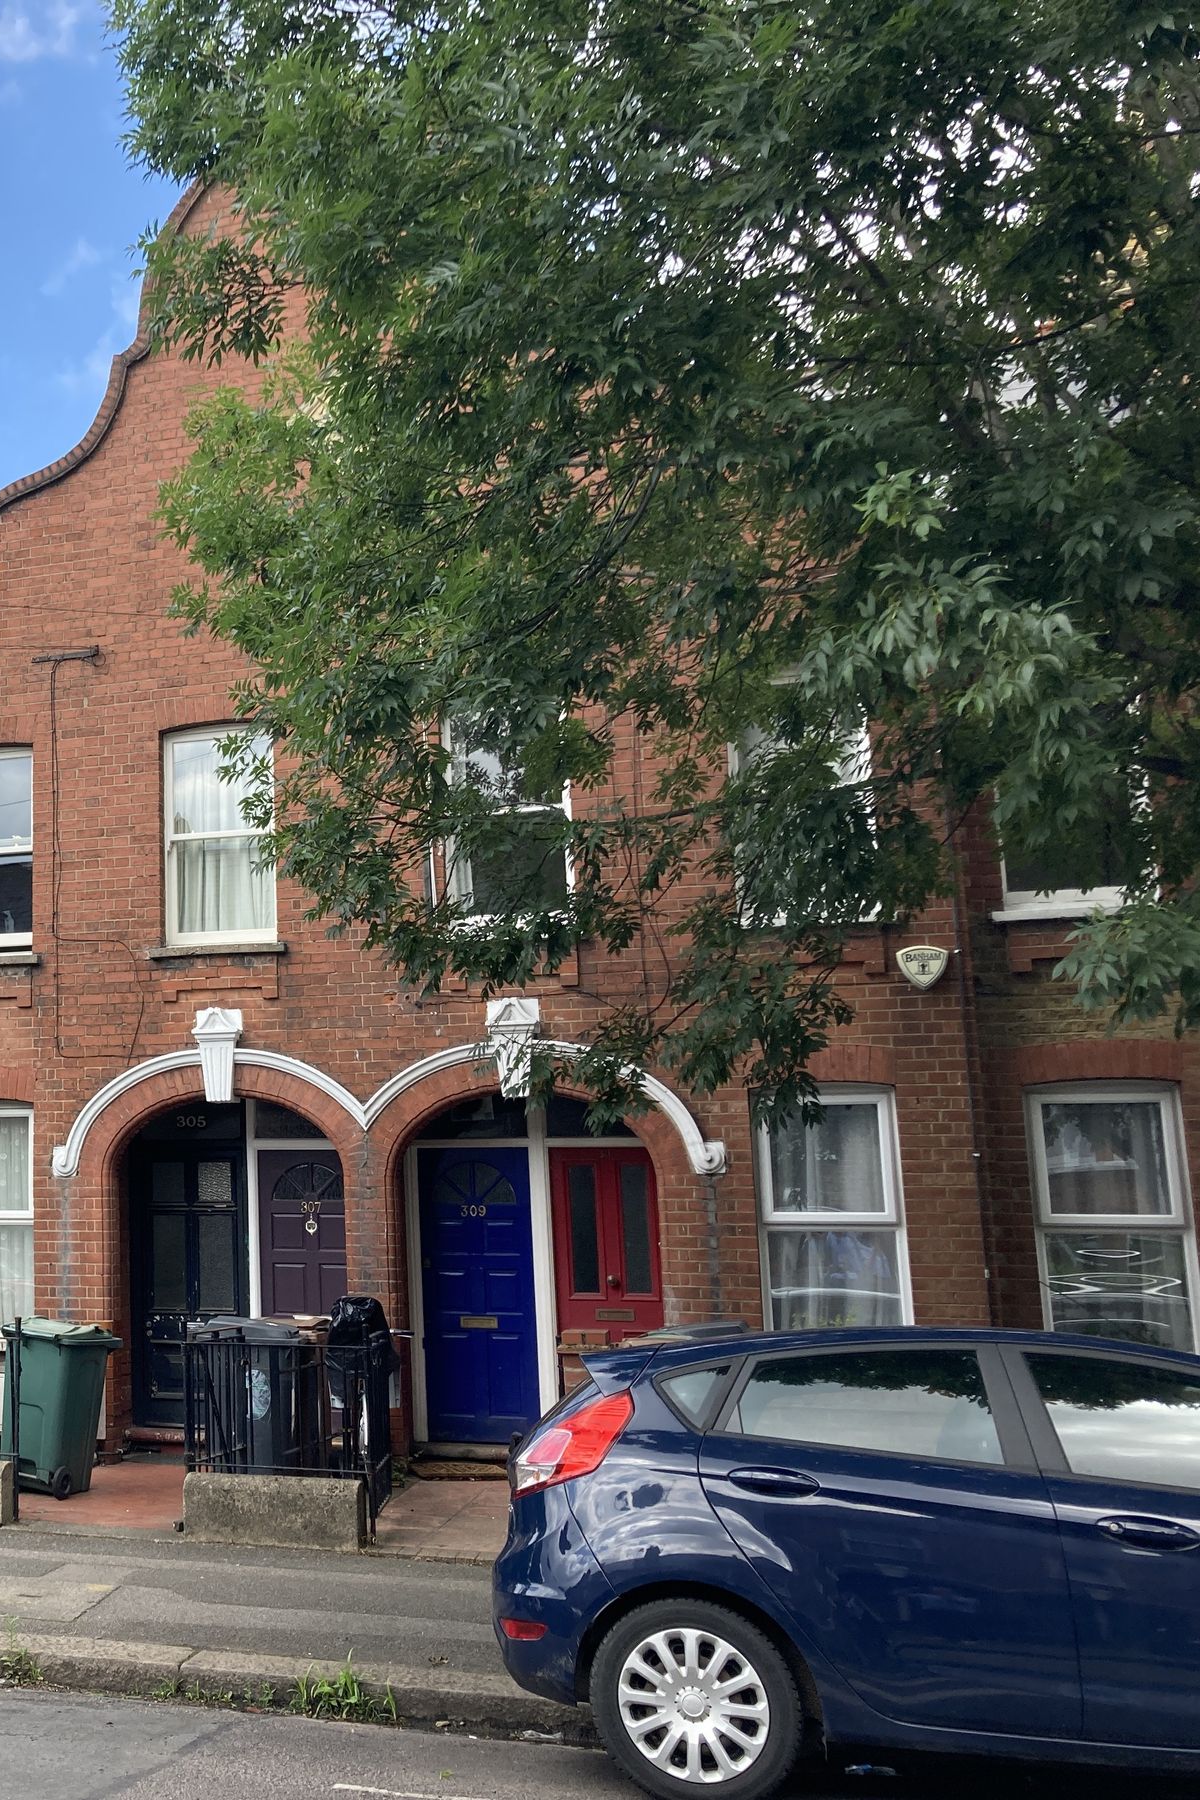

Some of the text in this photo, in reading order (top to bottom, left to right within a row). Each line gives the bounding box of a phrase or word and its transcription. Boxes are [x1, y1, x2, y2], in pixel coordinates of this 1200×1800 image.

[905, 952, 942, 963] BANHAM
[176, 1115, 207, 1128] 305
[300, 1201, 322, 1213] 307
[460, 1204, 487, 1217] 309
